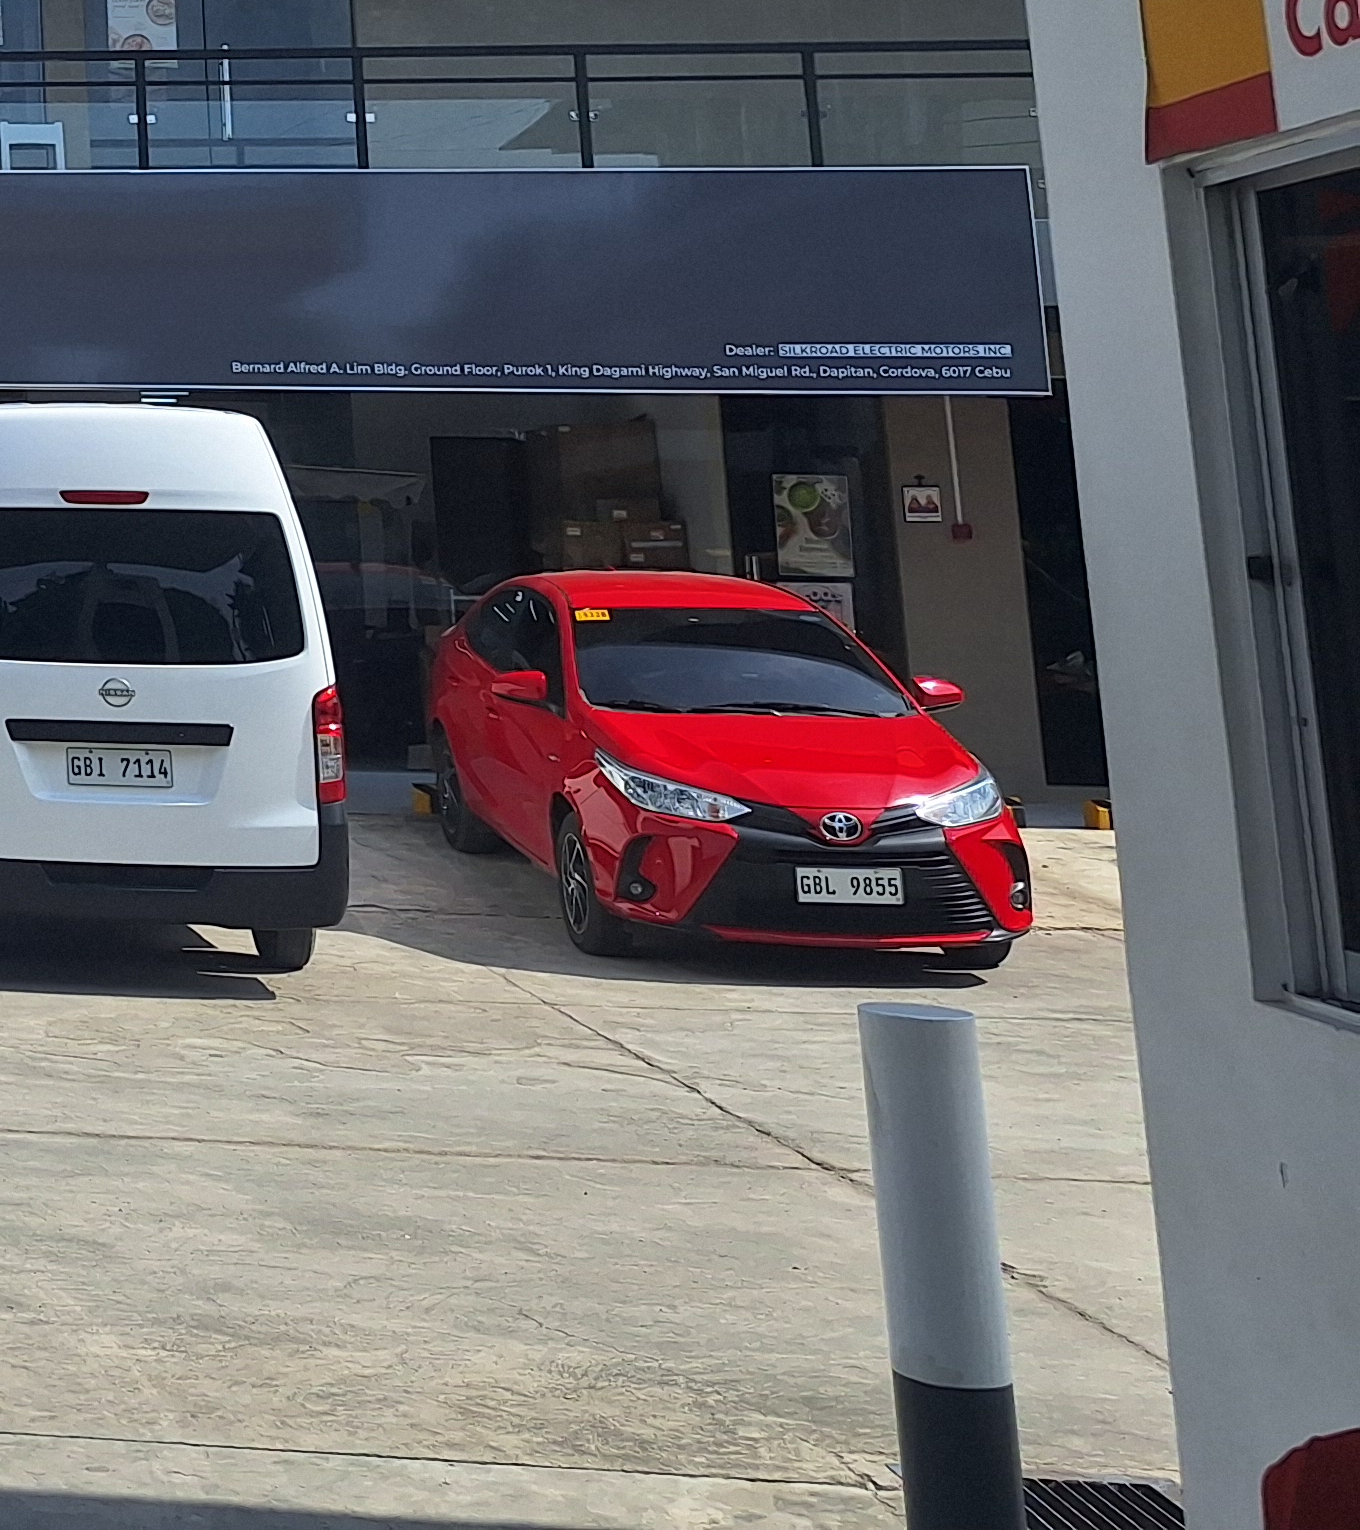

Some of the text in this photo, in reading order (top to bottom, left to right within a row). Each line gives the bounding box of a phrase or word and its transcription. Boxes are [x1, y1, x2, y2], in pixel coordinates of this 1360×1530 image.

[725, 344, 1011, 356] Dealer: SILKROAD ELECTRIC MOTORS INC.
[232, 362, 284, 373] Bernard
[287, 362, 327, 374] Alfred
[330, 363, 344, 374] A.
[346, 363, 371, 374] Lim
[374, 363, 408, 377] Bldg.
[411, 364, 461, 376] Ground
[464, 364, 501, 377] Floor,
[504, 364, 544, 376] Purok
[559, 365, 590, 378] King
[593, 365, 645, 378] Dagami
[649, 365, 711, 379] Highway,
[713, 365, 739, 377] San
[742, 365, 788, 379] Miguel
[820, 365, 877, 379] Dapitan,
[880, 366, 939, 379] Cordova,
[941, 366, 971, 377] 6017
[975, 365, 1011, 377] Cebu
[99, 689, 135, 697] NISSAN
[71, 756, 169, 779] GBI 7114
[800, 875, 900, 897] GBL 9855
